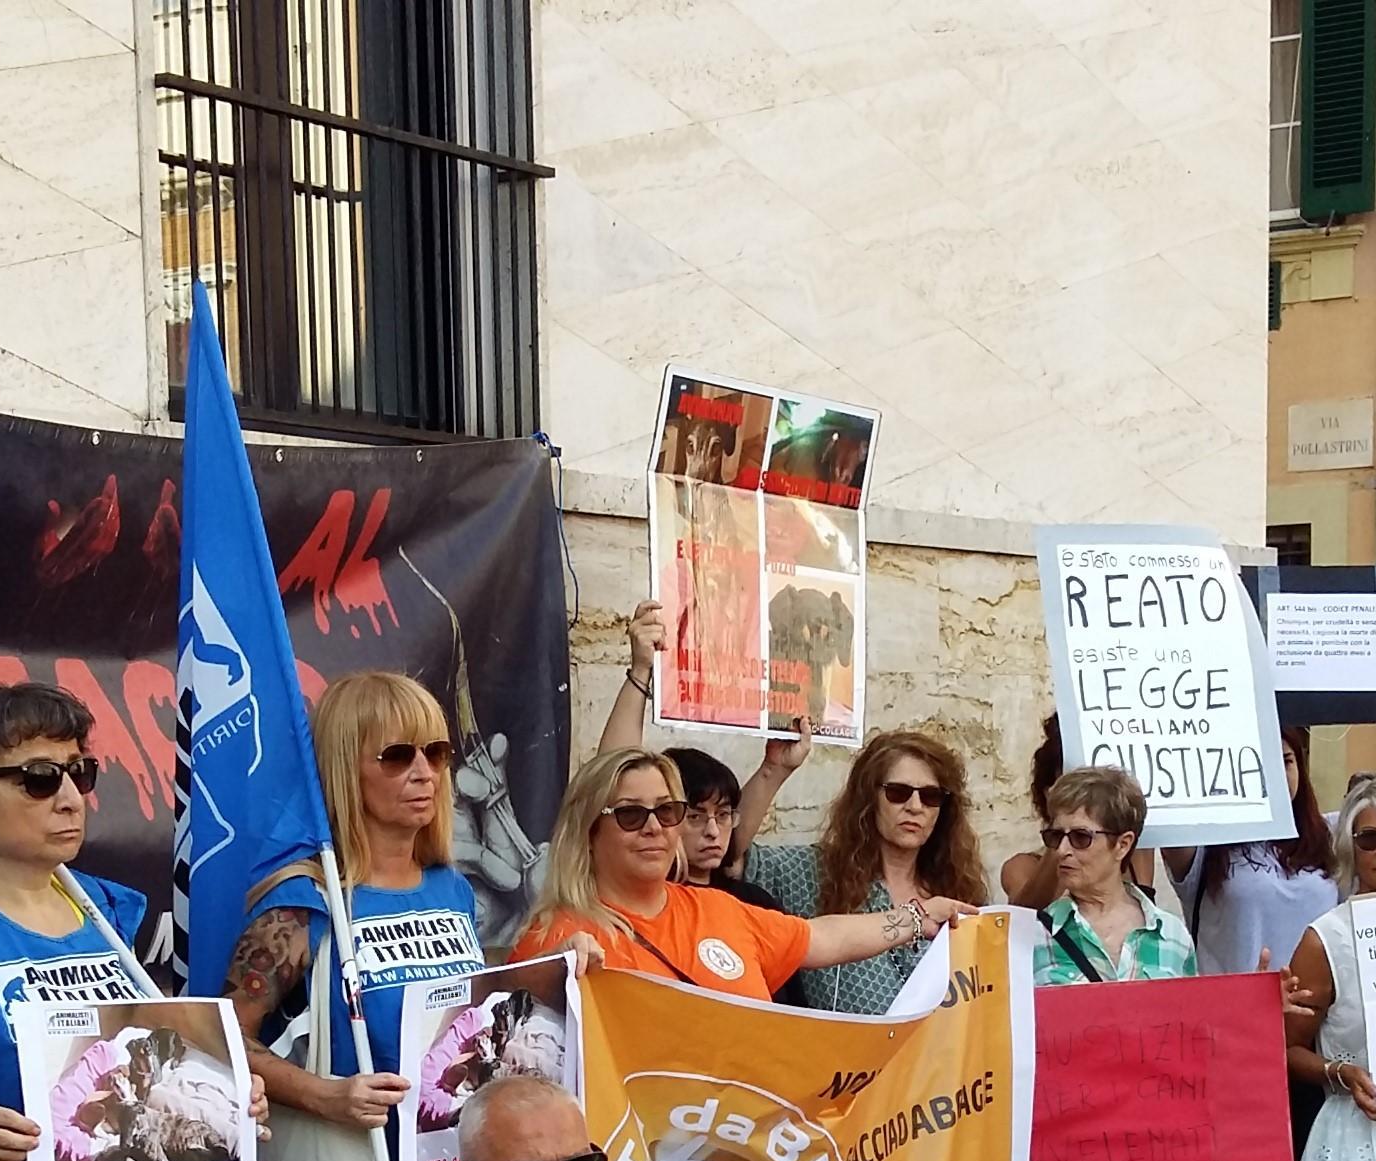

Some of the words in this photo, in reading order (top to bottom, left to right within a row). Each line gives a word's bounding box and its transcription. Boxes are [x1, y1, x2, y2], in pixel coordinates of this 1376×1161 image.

[1319, 415, 1341, 430] VIA
[279, 488, 400, 640] AL
[1129, 554, 1201, 569] commesso
[1065, 573, 1227, 629] REATO
[1073, 638, 1139, 664] esiste
[1154, 648, 1193, 665] una
[1078, 666, 1231, 712] LEGGE
[1091, 717, 1211, 736] VOGLIAMO
[361, 917, 458, 944] ANIMALIST
[1035, 1018, 1217, 1071] IUSTIZIA
[1136, 1072, 1208, 1102] CANI
